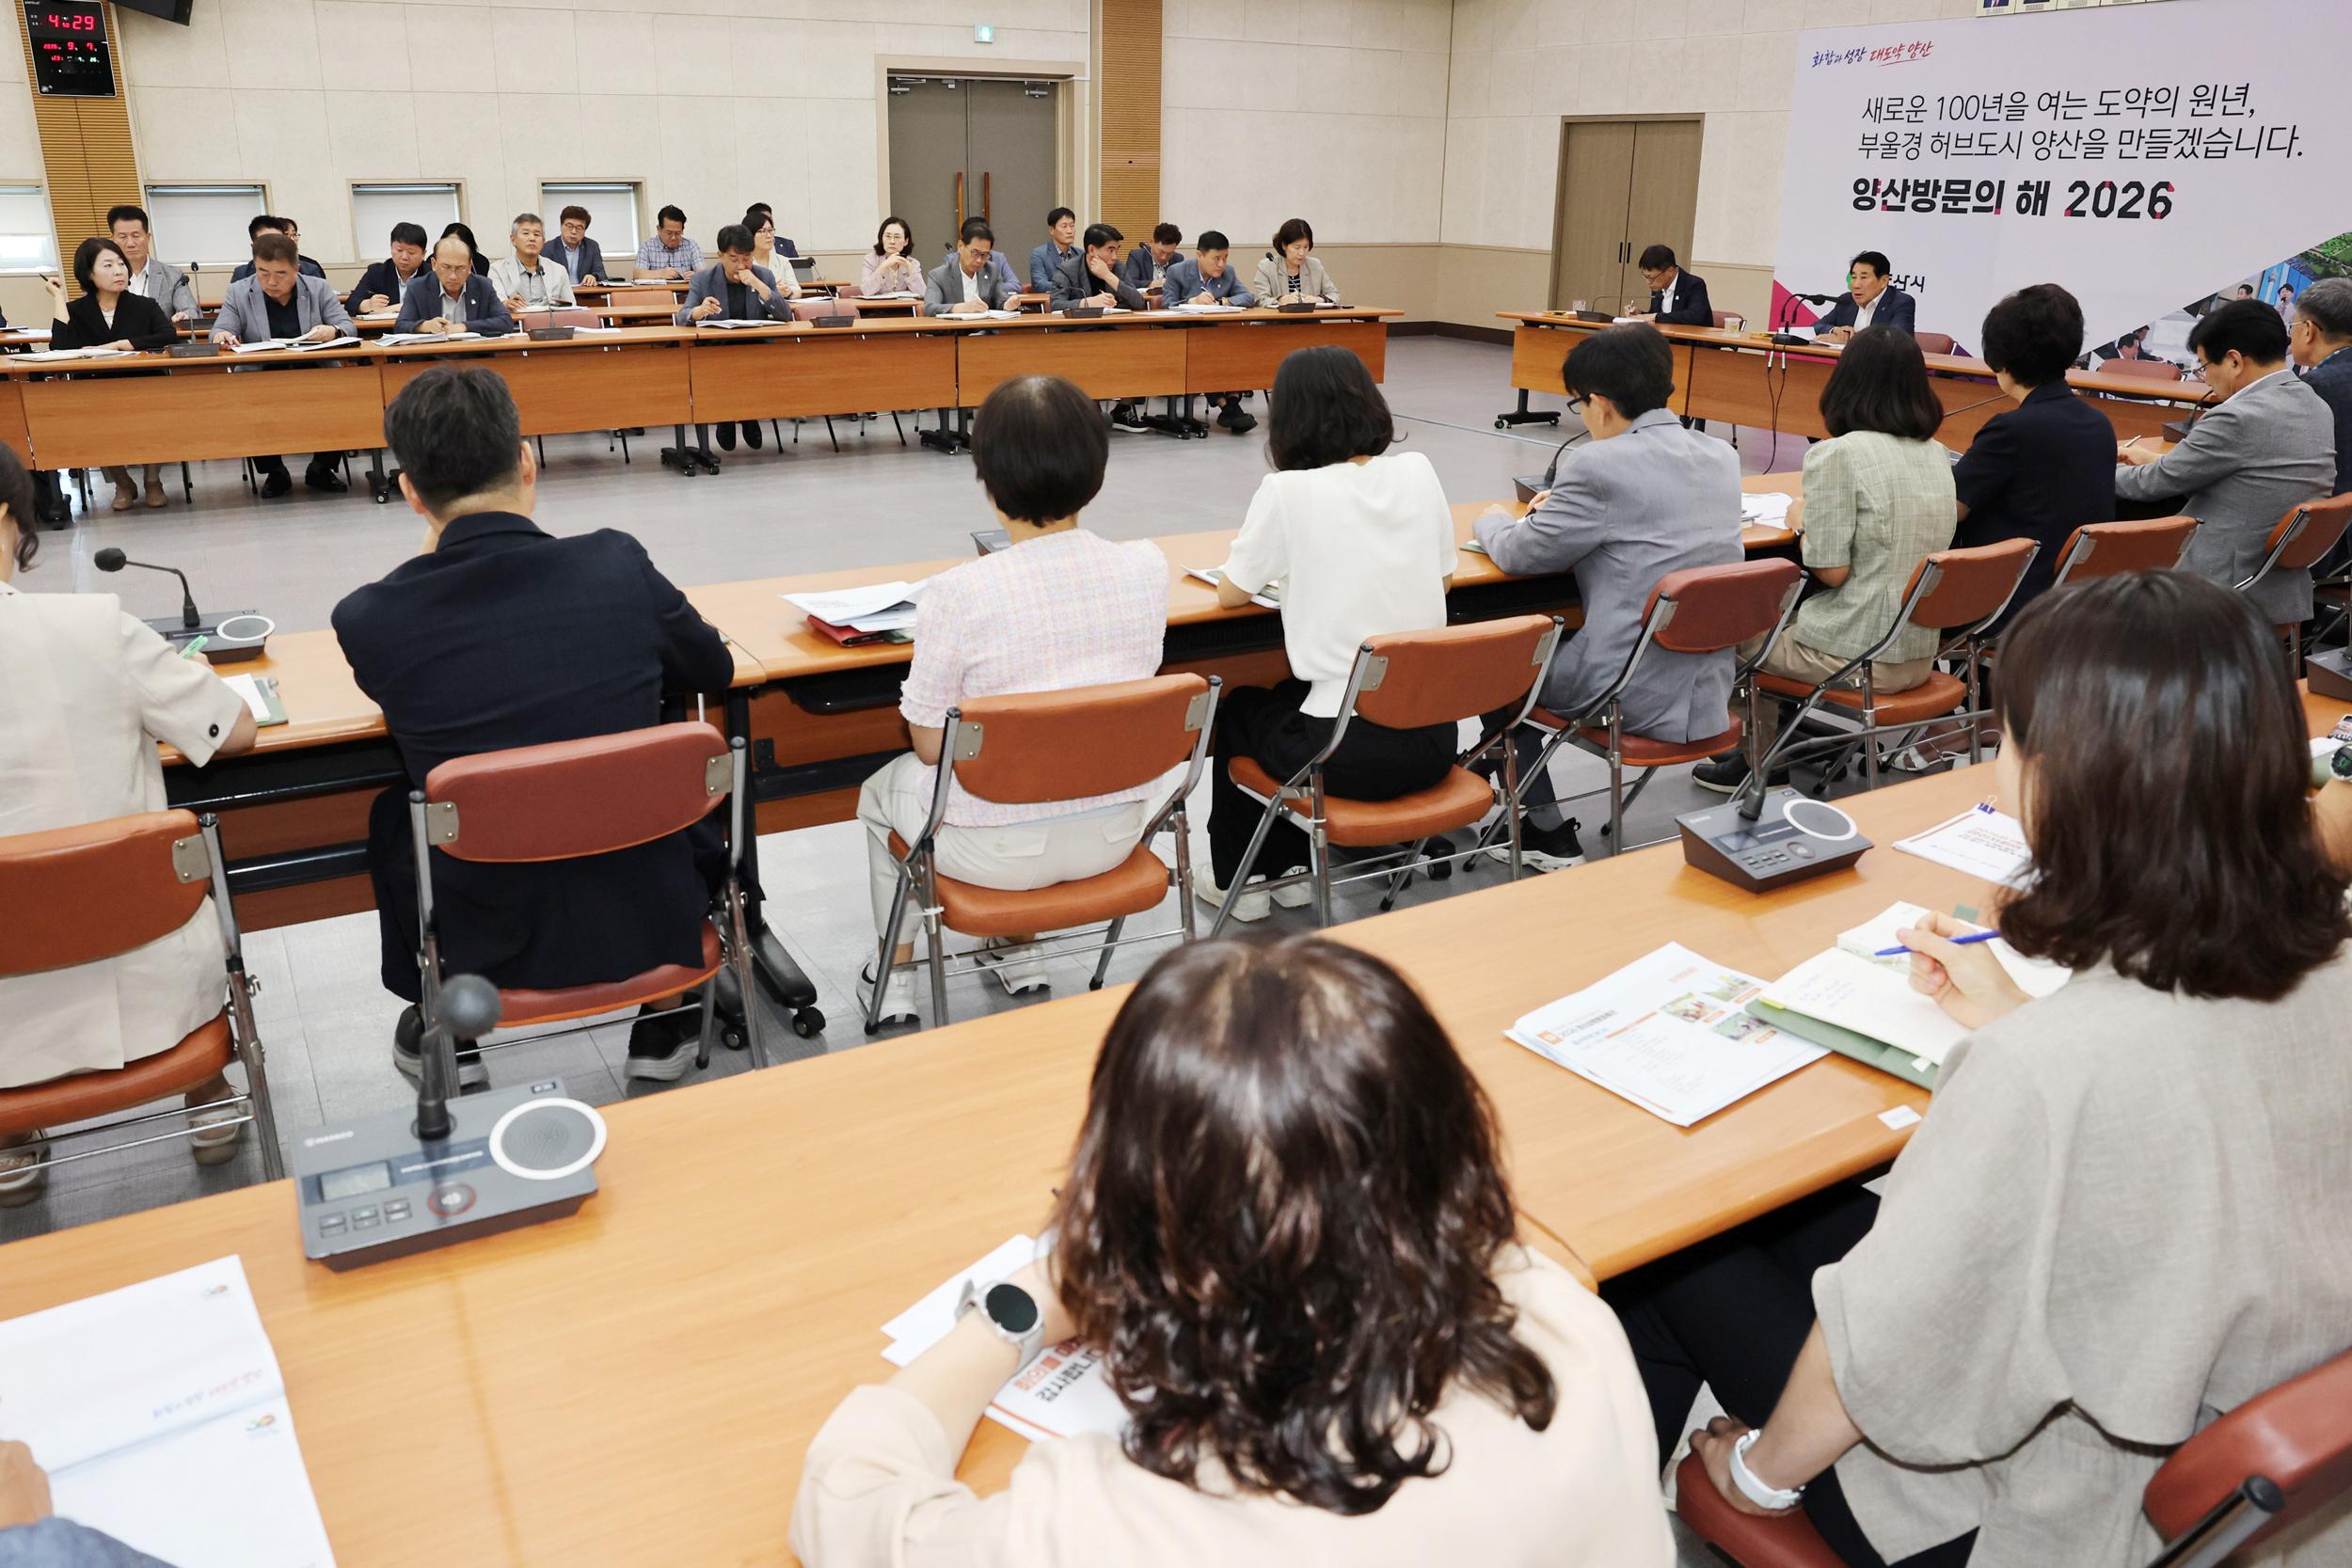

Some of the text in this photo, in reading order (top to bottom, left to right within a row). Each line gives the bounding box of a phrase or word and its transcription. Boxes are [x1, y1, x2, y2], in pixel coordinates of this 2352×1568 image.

[72, 15, 94, 30] 29
[1811, 41, 1935, 68] 화합과 성장 대도약 양산
[1862, 83, 2255, 124] 새로운 100년을 여는 도약의 원년,
[1858, 124, 2303, 161] 부울경 허브도시 양산을 만들겠습니다.
[1852, 178, 2175, 219] 양산방문의 해 2026
[1889, 274, 1925, 293] 산시
